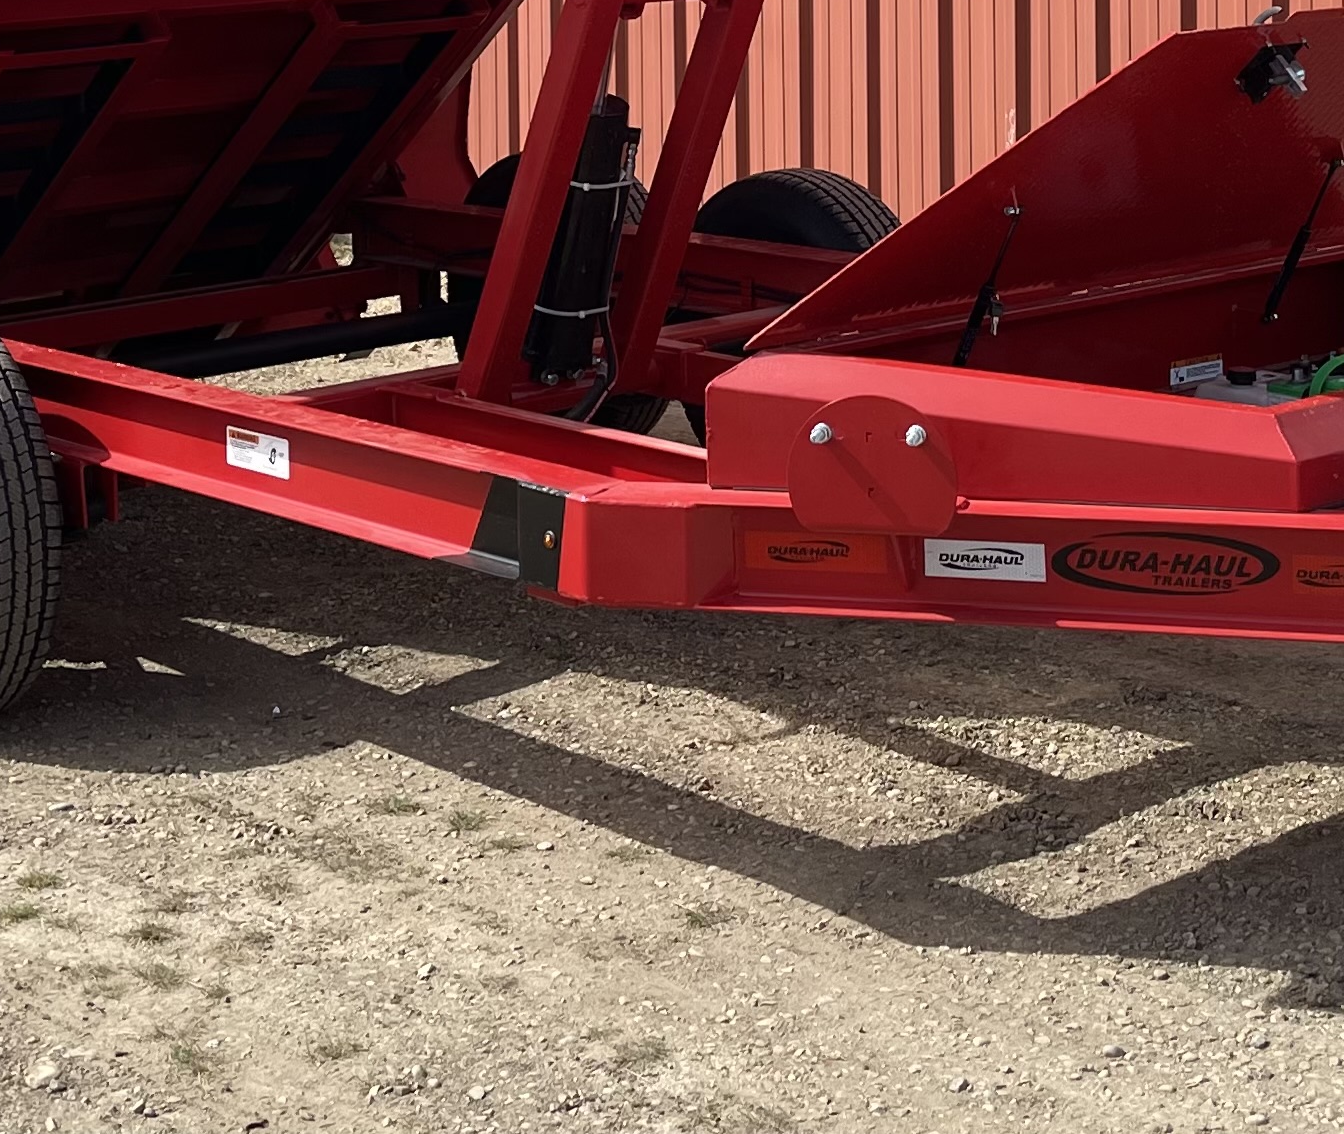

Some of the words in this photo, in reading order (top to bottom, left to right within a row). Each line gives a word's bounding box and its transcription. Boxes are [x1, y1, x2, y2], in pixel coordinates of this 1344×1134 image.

[938, 553, 1023, 566] DURA-HAUL
[1075, 548, 1252, 579] DURA-HAUL
[1152, 575, 1233, 590] TRAILERS
